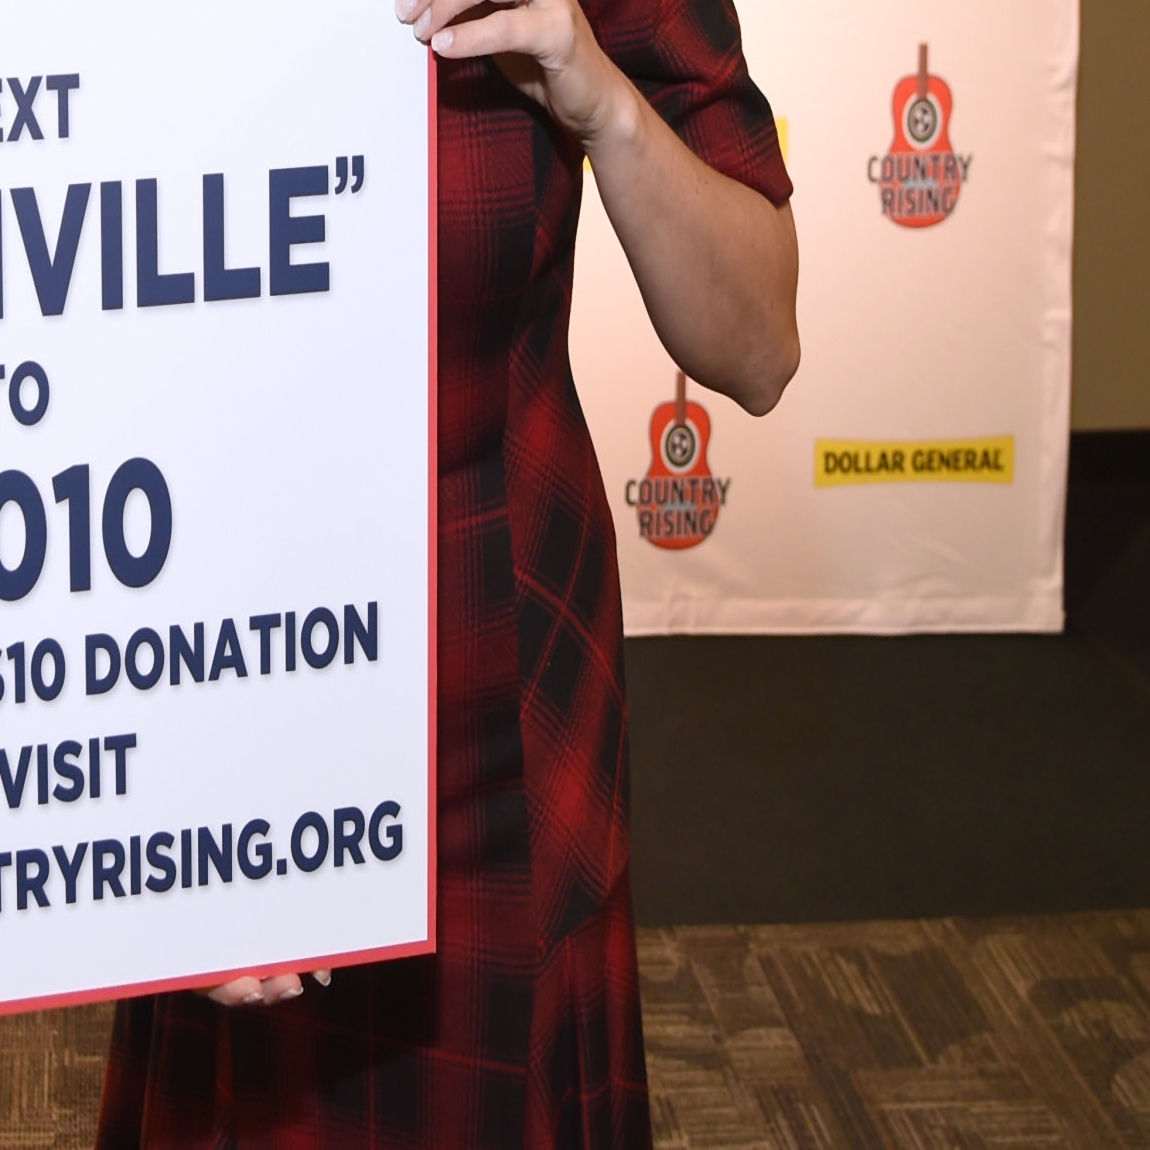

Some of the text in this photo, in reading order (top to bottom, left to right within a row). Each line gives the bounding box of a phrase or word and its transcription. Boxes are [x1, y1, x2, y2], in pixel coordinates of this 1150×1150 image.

[868, 154, 972, 185] COUNTRY
[882, 187, 956, 217] RISING
[825, 449, 1003, 474] DOLLAR GENERAL
[625, 478, 731, 508] COUNTRY
[639, 509, 715, 539] RISING
[85, 601, 377, 695] DONATION
